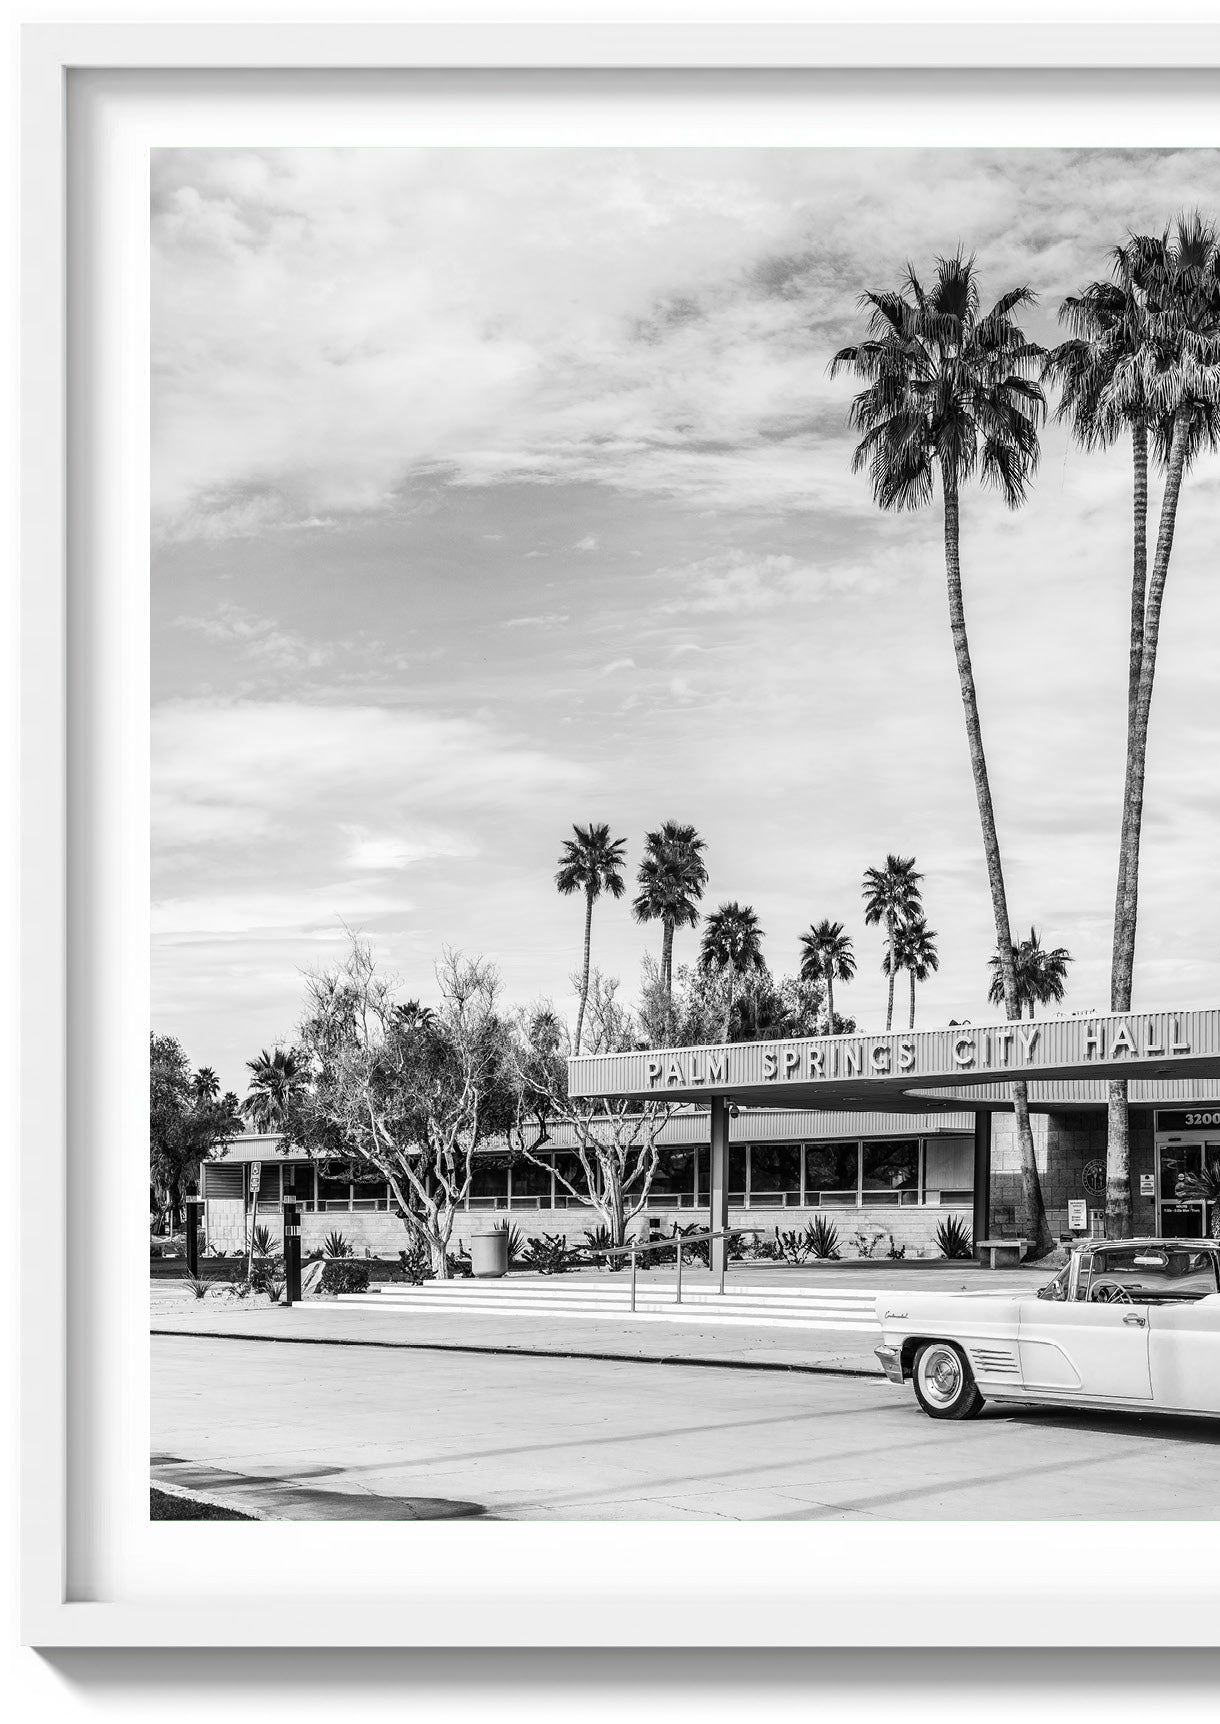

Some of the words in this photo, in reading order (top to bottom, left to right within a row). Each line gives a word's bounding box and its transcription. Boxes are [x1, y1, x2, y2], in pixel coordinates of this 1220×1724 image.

[647, 1053, 729, 1086] PALM
[761, 1040, 916, 1079] SPRINGS
[951, 1027, 1039, 1066] CITY
[1083, 1017, 1188, 1057] HALL
